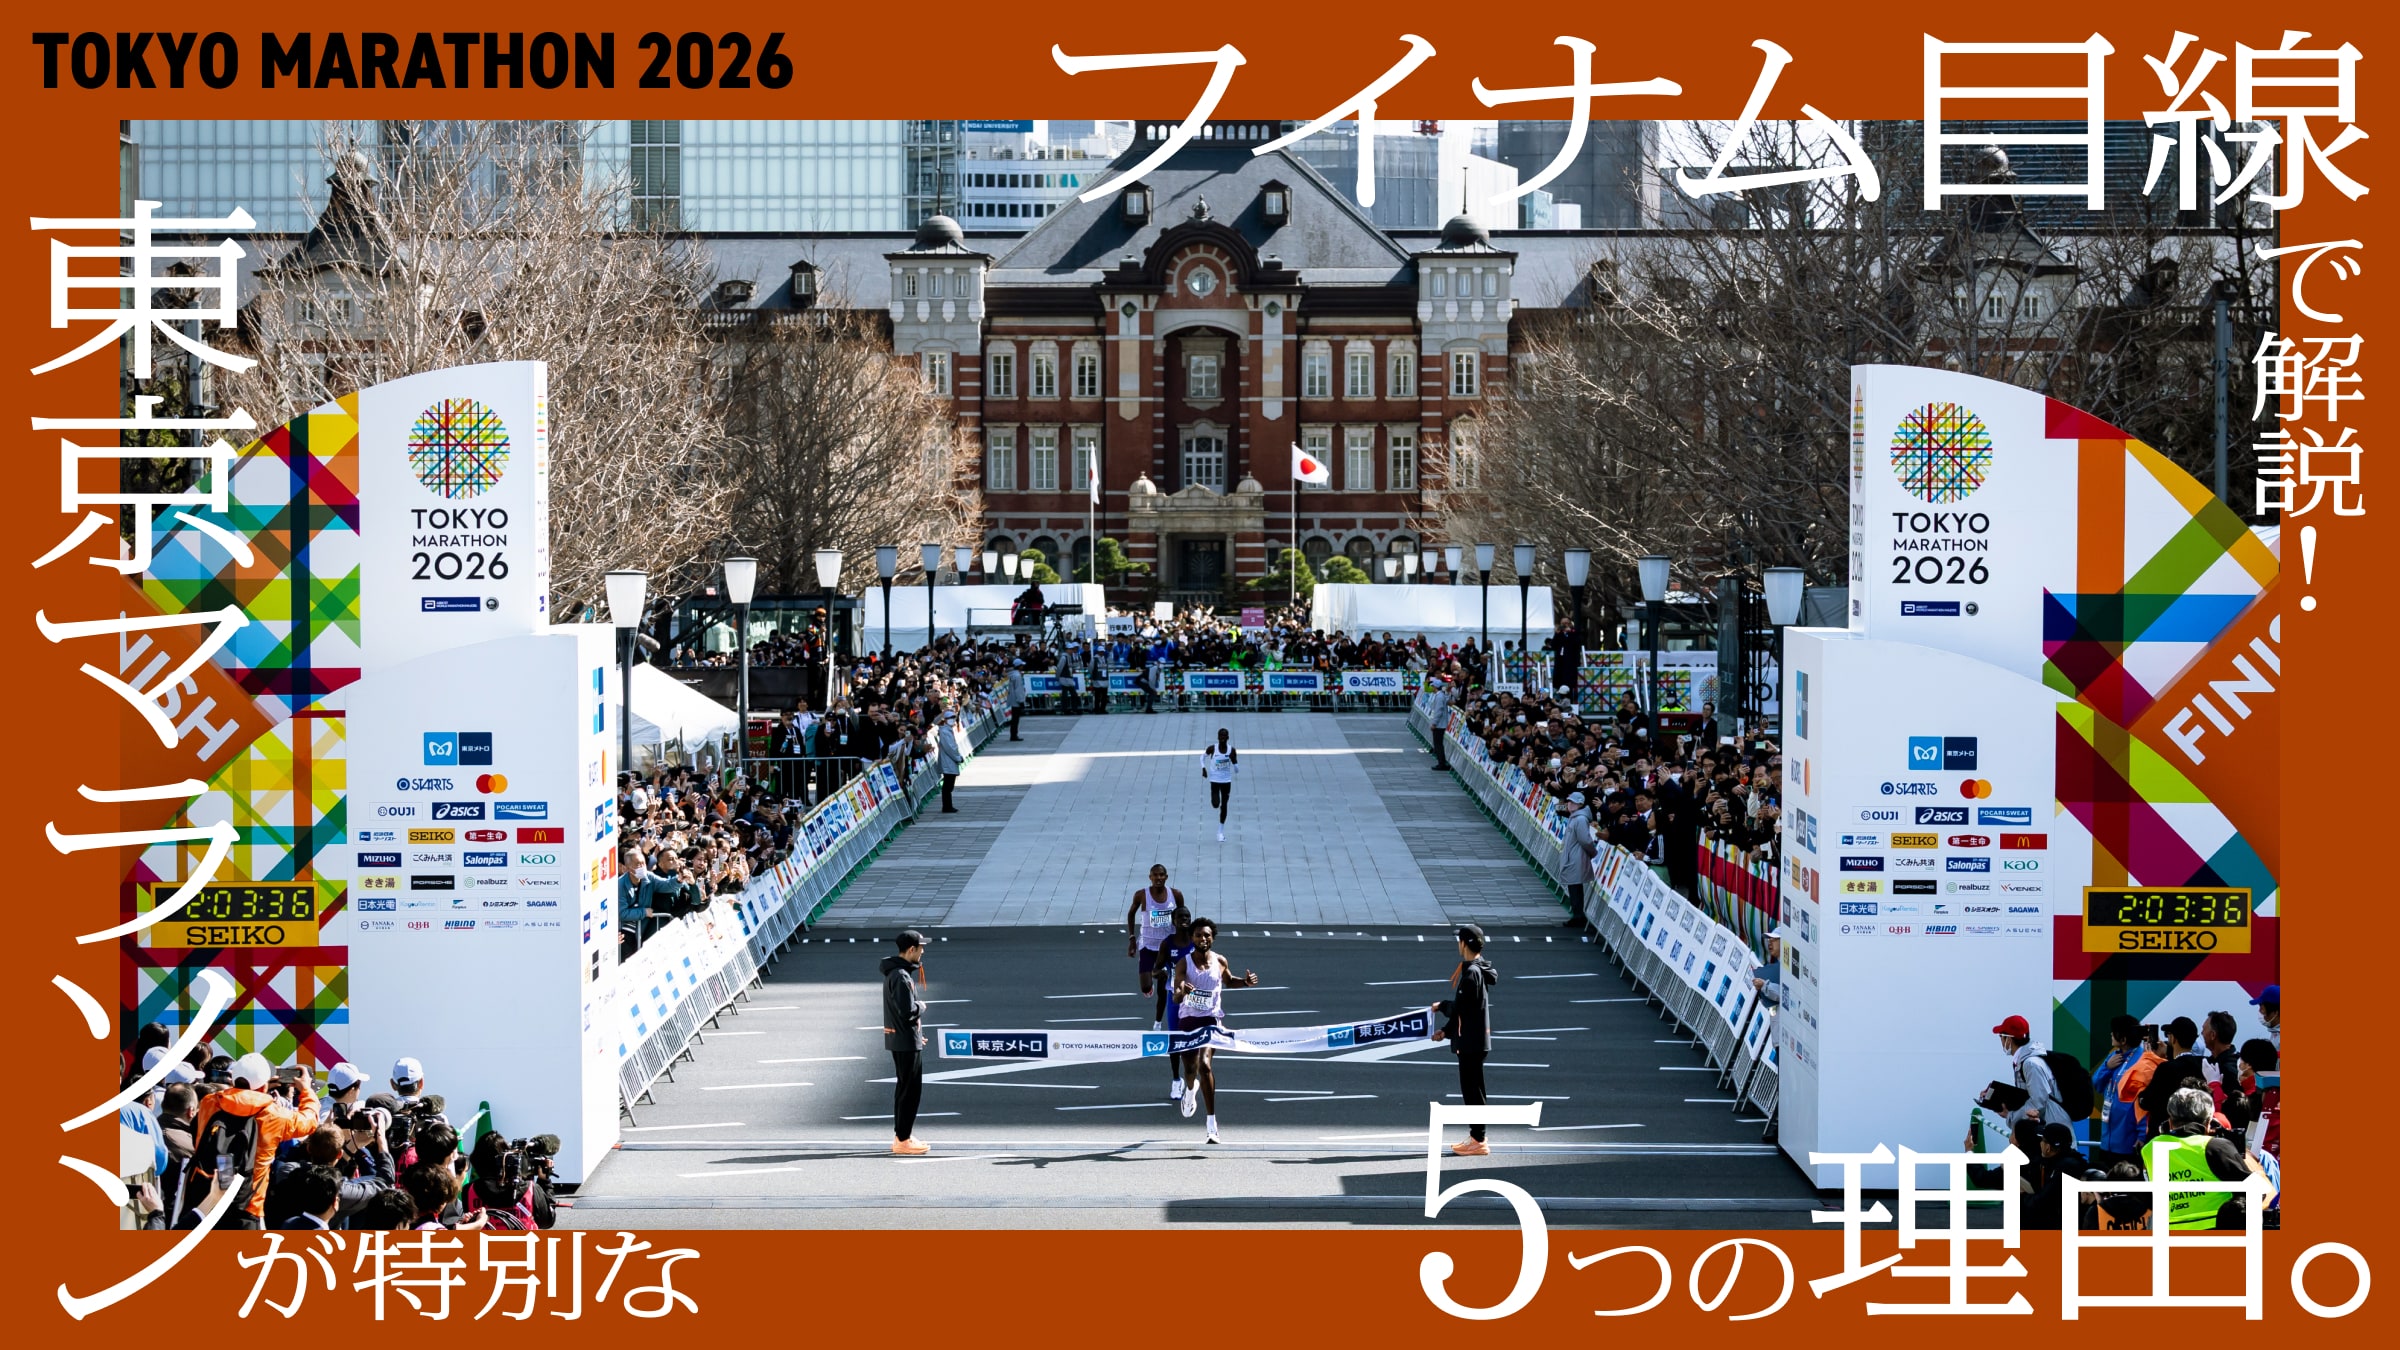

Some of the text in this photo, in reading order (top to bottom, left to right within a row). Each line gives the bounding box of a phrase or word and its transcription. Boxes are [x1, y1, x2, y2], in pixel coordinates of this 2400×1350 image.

[411, 508, 509, 529] TOKYO
[1892, 512, 1990, 533] TOKYO
[412, 534, 508, 547] MARATHON
[1893, 538, 1989, 551] MARATHON
[411, 551, 509, 580] 2026
[1891, 556, 1990, 584] 2026
[2162, 613, 2281, 766] FINI
[388, 806, 415, 816] OUJI
[1871, 810, 1899, 821] OUJI
[409, 831, 454, 841] SEIKO
[1892, 836, 1937, 846] SEIKO
[465, 855, 504, 866] Salonpas
[1947, 860, 1986, 871] Salonpas
[364, 877, 395, 888] きき湯
[476, 878, 508, 886] realbuzz
[1846, 881, 1877, 892] きき湯
[359, 900, 396, 910] 日本光電
[1840, 903, 1877, 914] 日本光電
[2118, 895, 2241, 923] 2:03:36
[186, 925, 285, 946] SEIKO
[2118, 930, 2218, 951] SEIKO
[1358, 1019, 1424, 1038] 東京メトロ
[977, 1039, 1043, 1052] 東京メトロ
